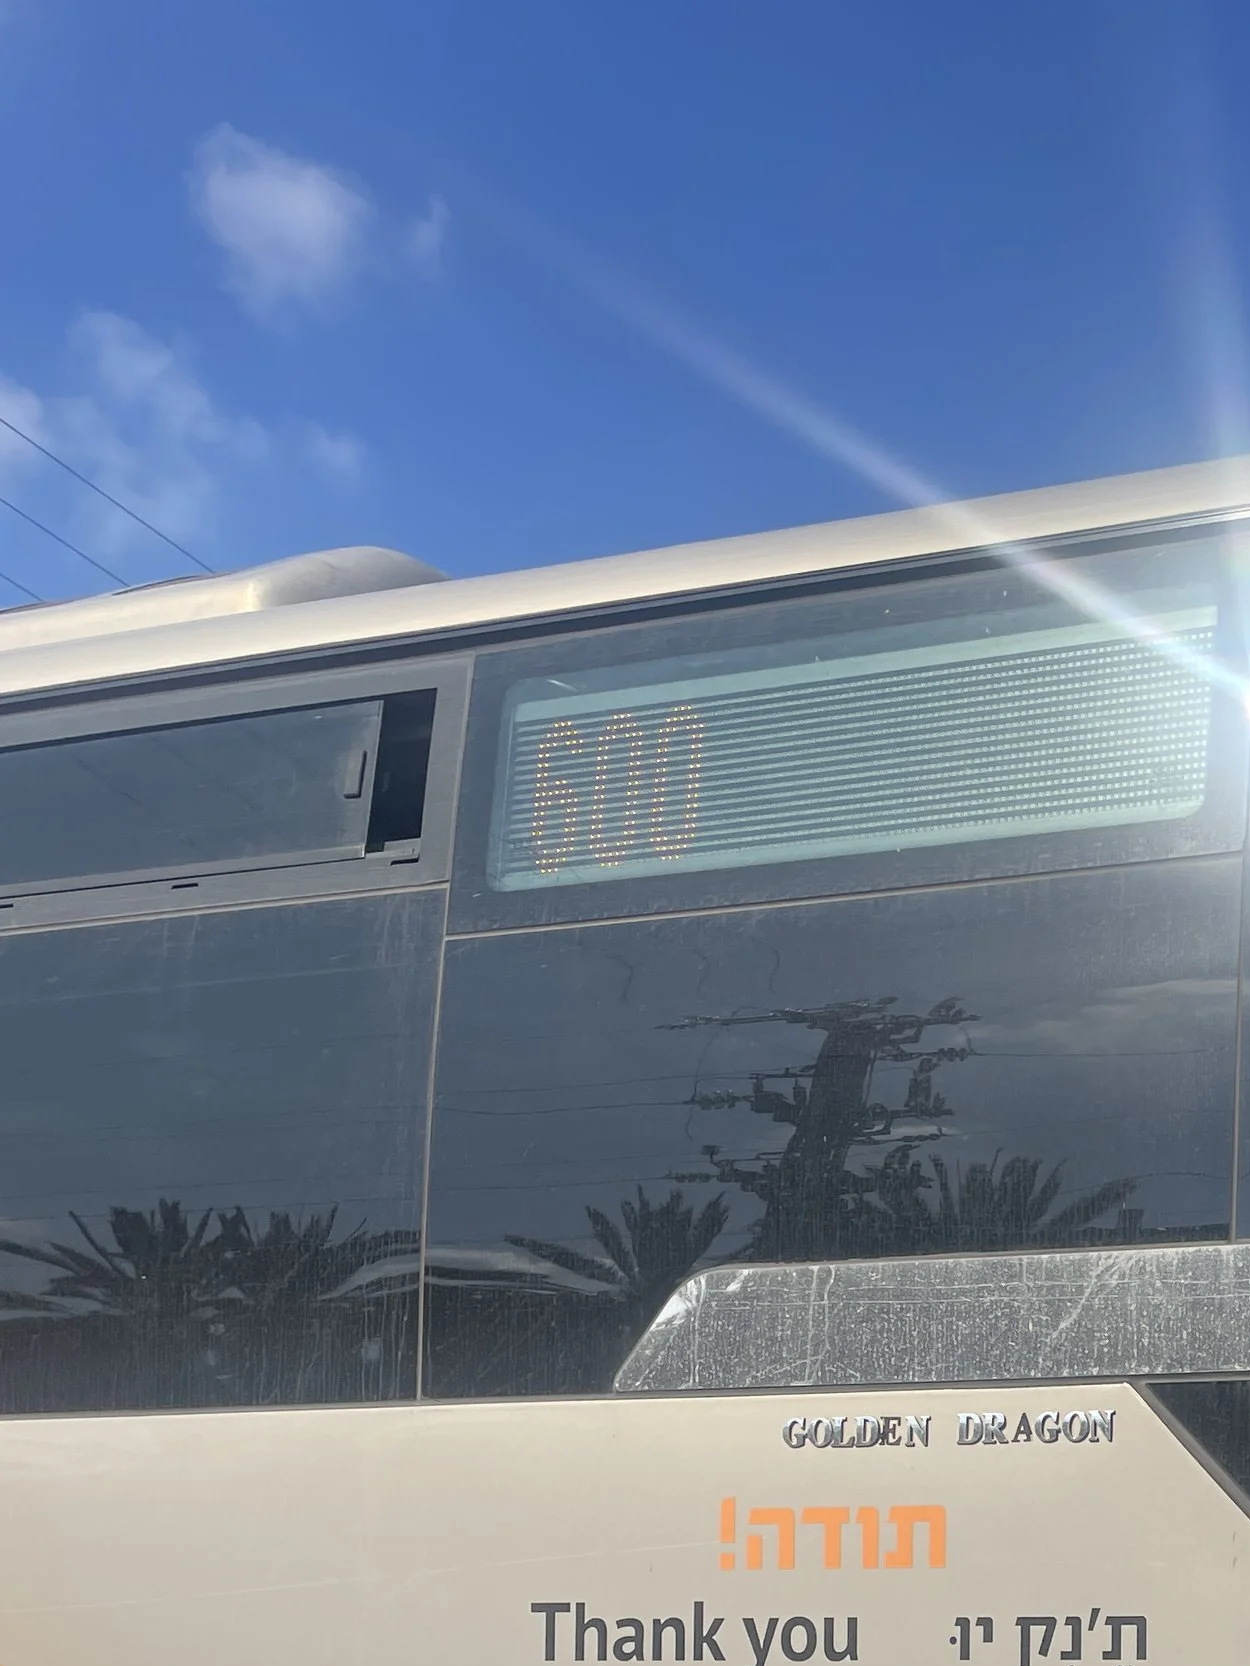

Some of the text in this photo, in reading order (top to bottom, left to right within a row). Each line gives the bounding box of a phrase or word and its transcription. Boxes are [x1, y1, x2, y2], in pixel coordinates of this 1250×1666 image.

[531, 705, 706, 873] 600
[782, 1409, 1115, 1448] GOLDEN DRAGON
[720, 1497, 946, 1570] תודה!
[531, 1601, 726, 1661] Thank
